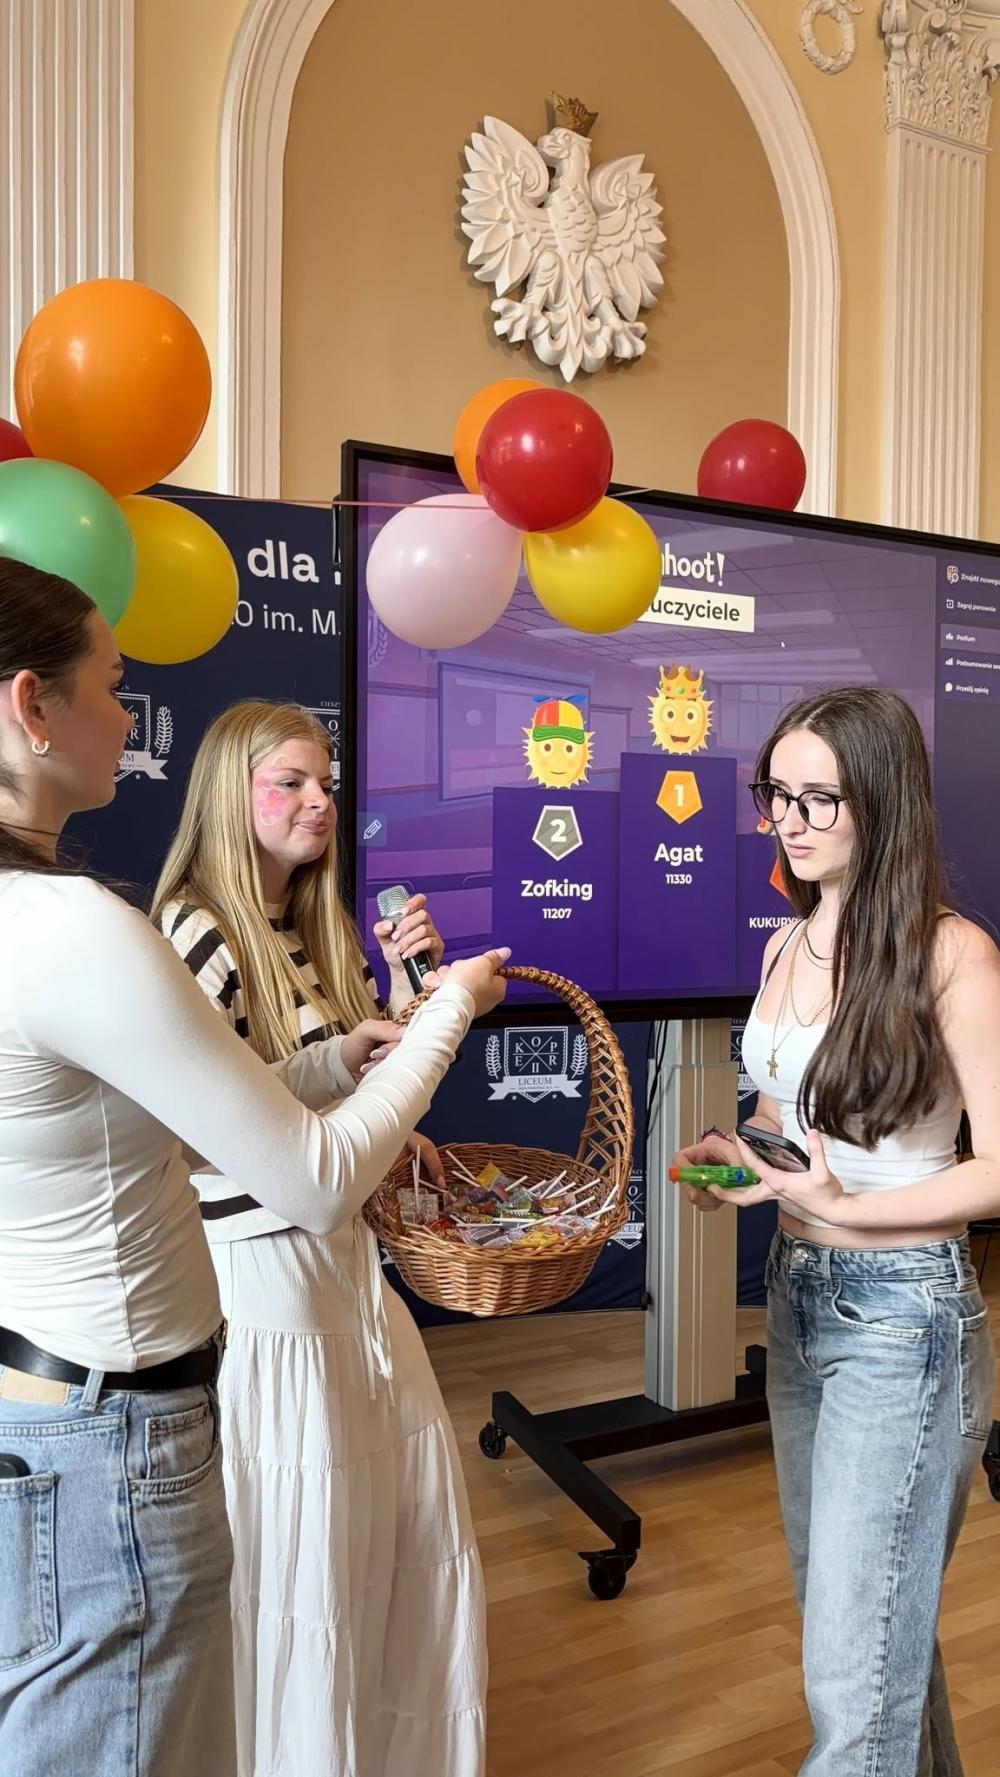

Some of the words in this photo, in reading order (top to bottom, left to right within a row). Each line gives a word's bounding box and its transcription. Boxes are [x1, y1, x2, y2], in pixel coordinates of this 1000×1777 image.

[247, 539, 320, 584] dla
[262, 604, 304, 633] im.
[648, 599, 740, 622] uczyciele
[956, 634, 976, 643] Podium
[674, 784, 684, 808] 1
[549, 818, 567, 843] 2
[654, 843, 704, 866] Agat
[520, 879, 593, 902] Zofking
[665, 874, 692, 885] 11330
[542, 908, 572, 920] 11207
[518, 1077, 552, 1086] LICEUM
